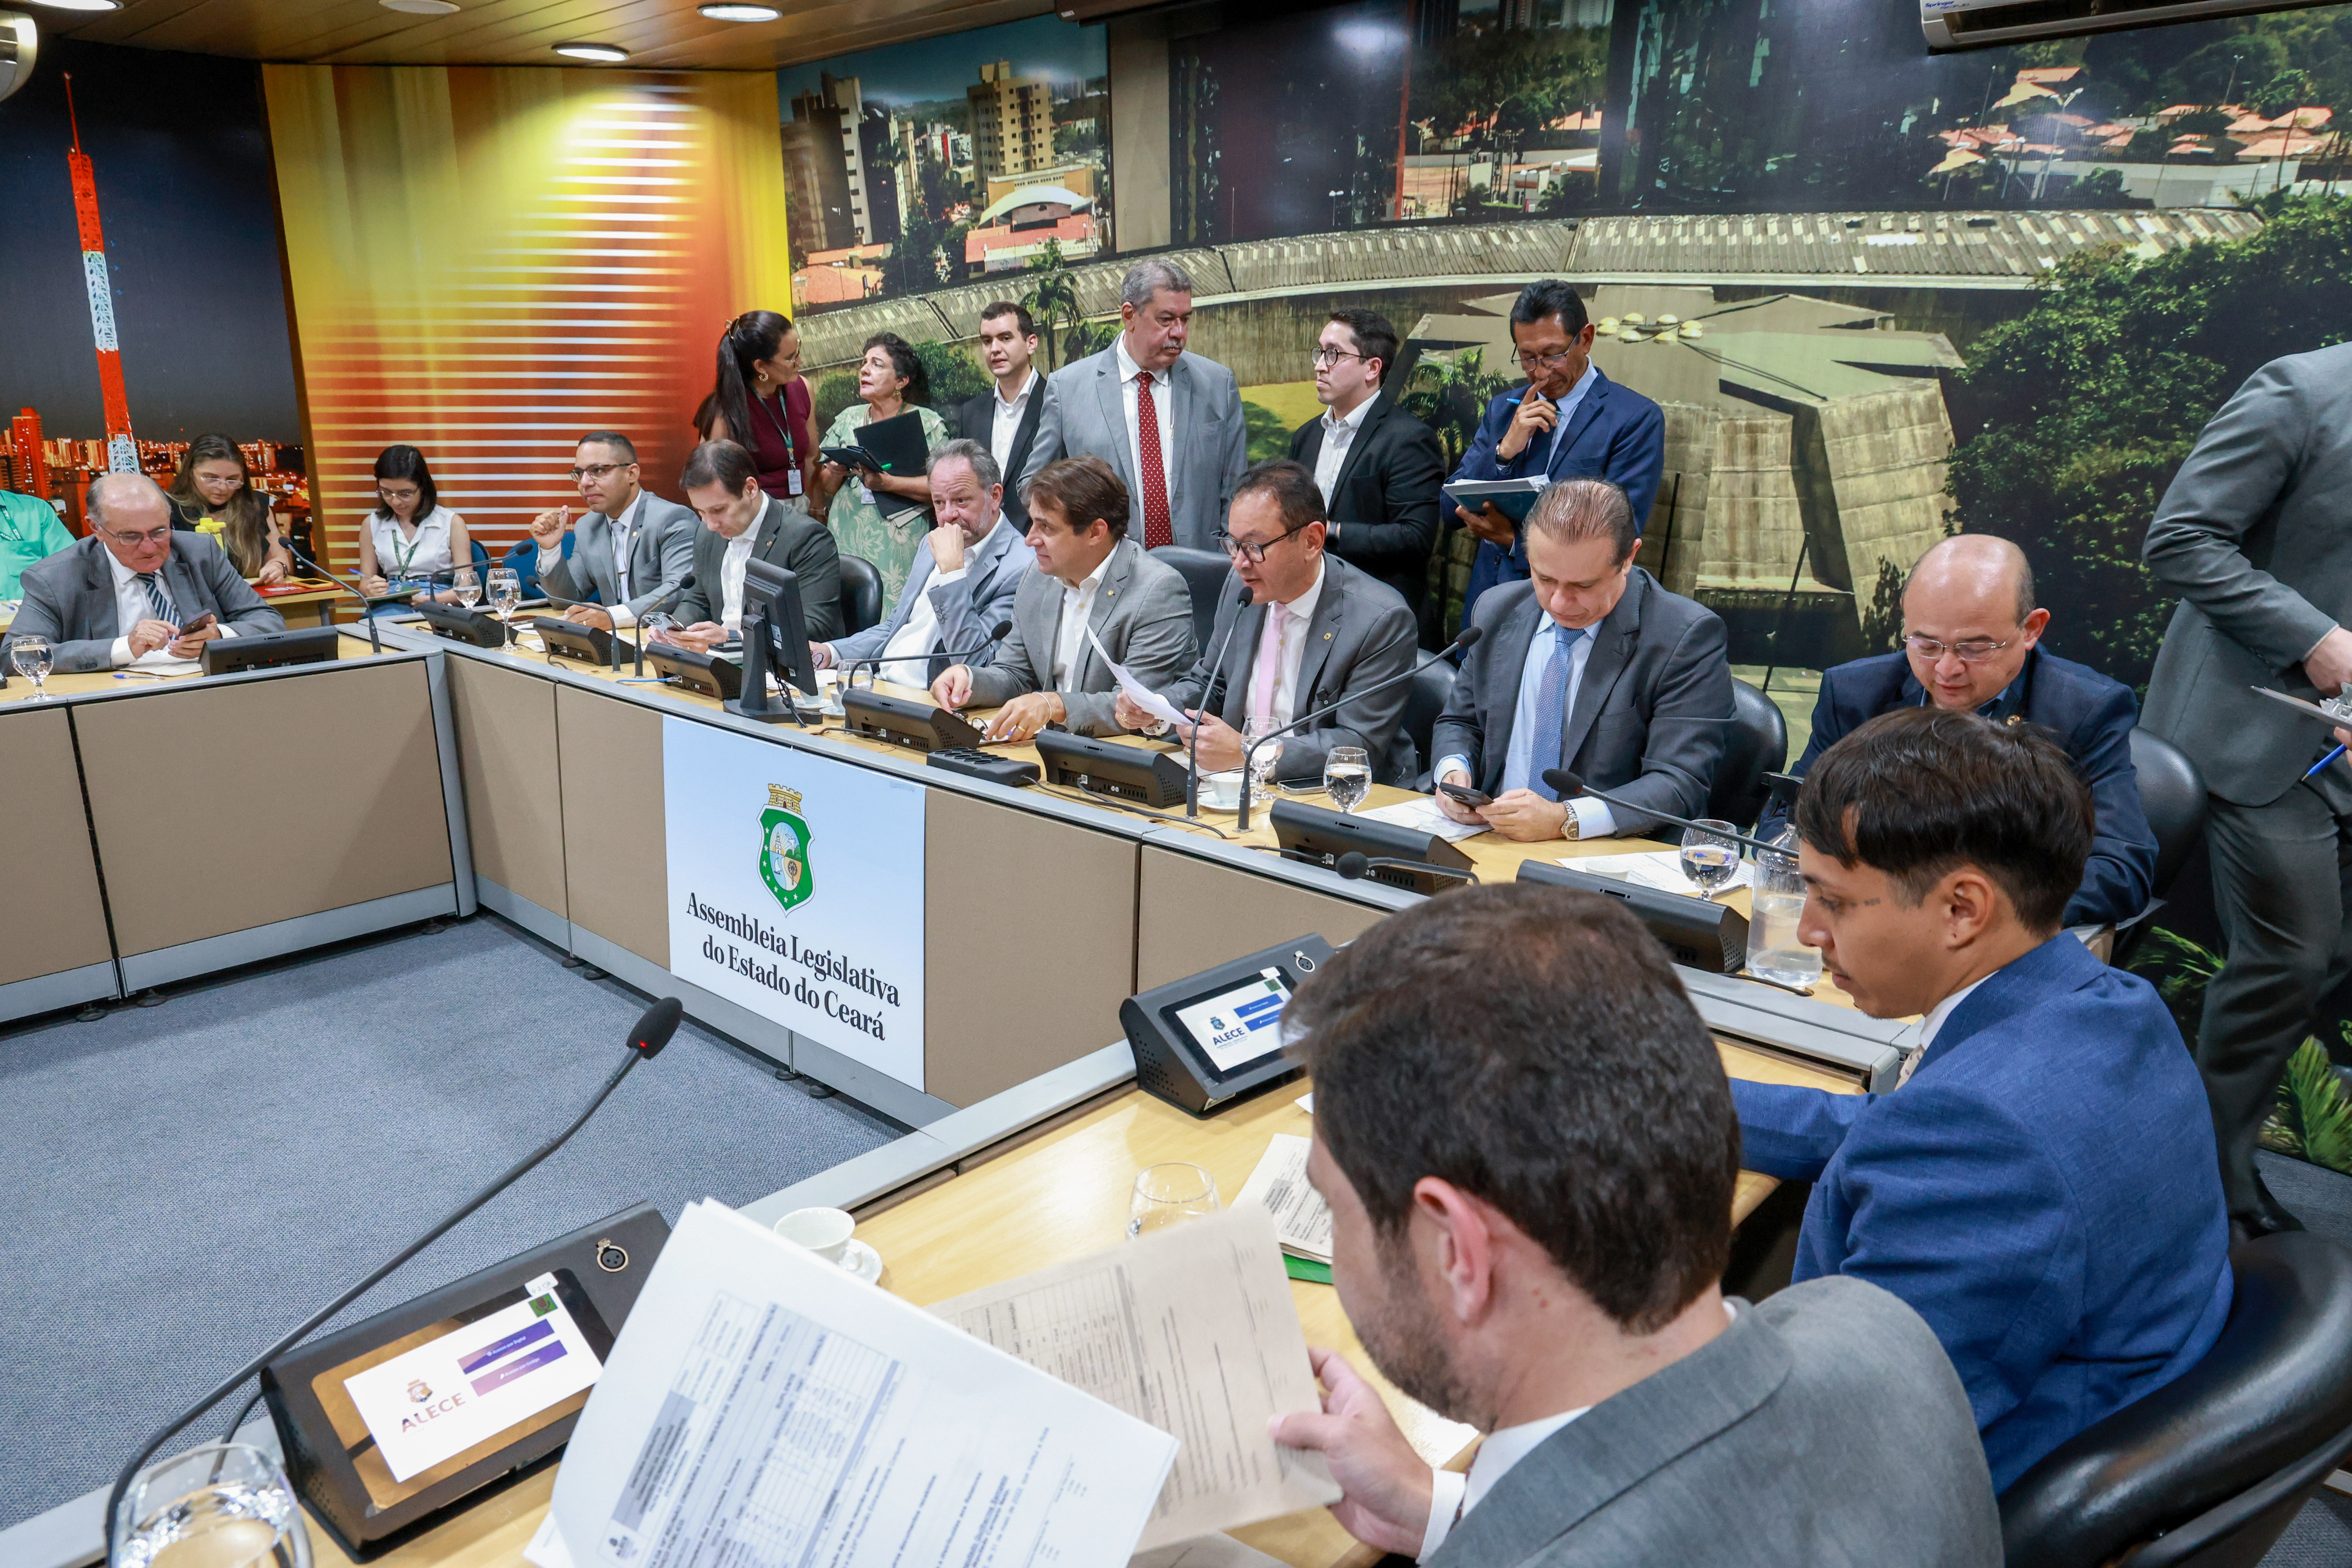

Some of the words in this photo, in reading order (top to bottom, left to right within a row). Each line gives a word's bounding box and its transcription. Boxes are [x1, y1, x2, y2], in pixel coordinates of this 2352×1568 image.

[686, 892, 788, 957] Assembleia
[791, 935, 900, 1007] Legislativa
[702, 935, 724, 964] do
[728, 944, 790, 996] Estado
[794, 976, 820, 1009] do
[824, 990, 885, 1041] Ceará
[1213, 1027, 1245, 1045] ALECE
[402, 1392, 465, 1432] ALECE
